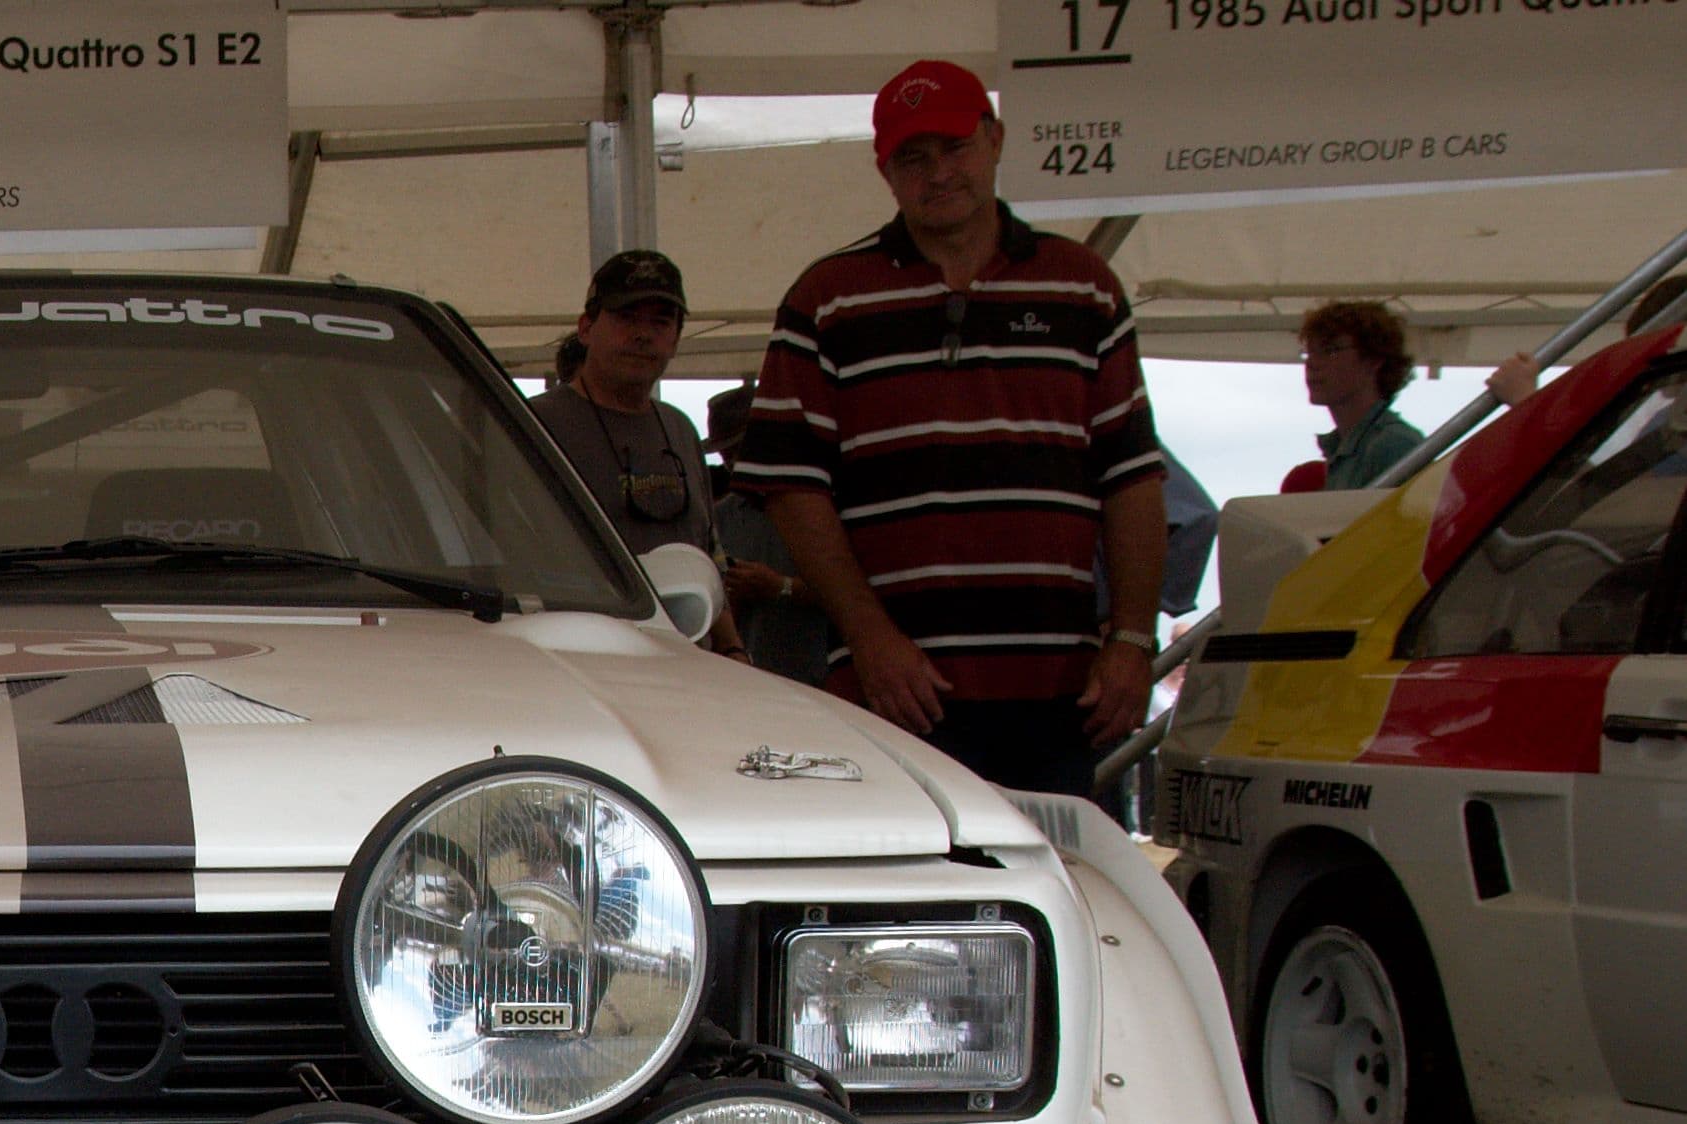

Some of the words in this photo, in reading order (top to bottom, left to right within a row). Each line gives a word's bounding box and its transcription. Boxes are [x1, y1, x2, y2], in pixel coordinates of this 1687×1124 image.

[1061, 0, 1130, 51] 17
[1166, 0, 1266, 31] 1985
[1281, 0, 1376, 25] Audi
[157, 33, 199, 69] S1
[217, 32, 262, 66] E2
[1032, 120, 1123, 142] SHELTER
[1041, 144, 1117, 176] 424
[1165, 143, 1313, 172] LEGENDARY
[1320, 138, 1414, 165] GROUP
[1420, 137, 1435, 159] B
[1443, 132, 1509, 159] CARS
[122, 519, 262, 541] RECARO
[1282, 780, 1373, 810] MICHELIN
[500, 1008, 564, 1024] BOSCH
